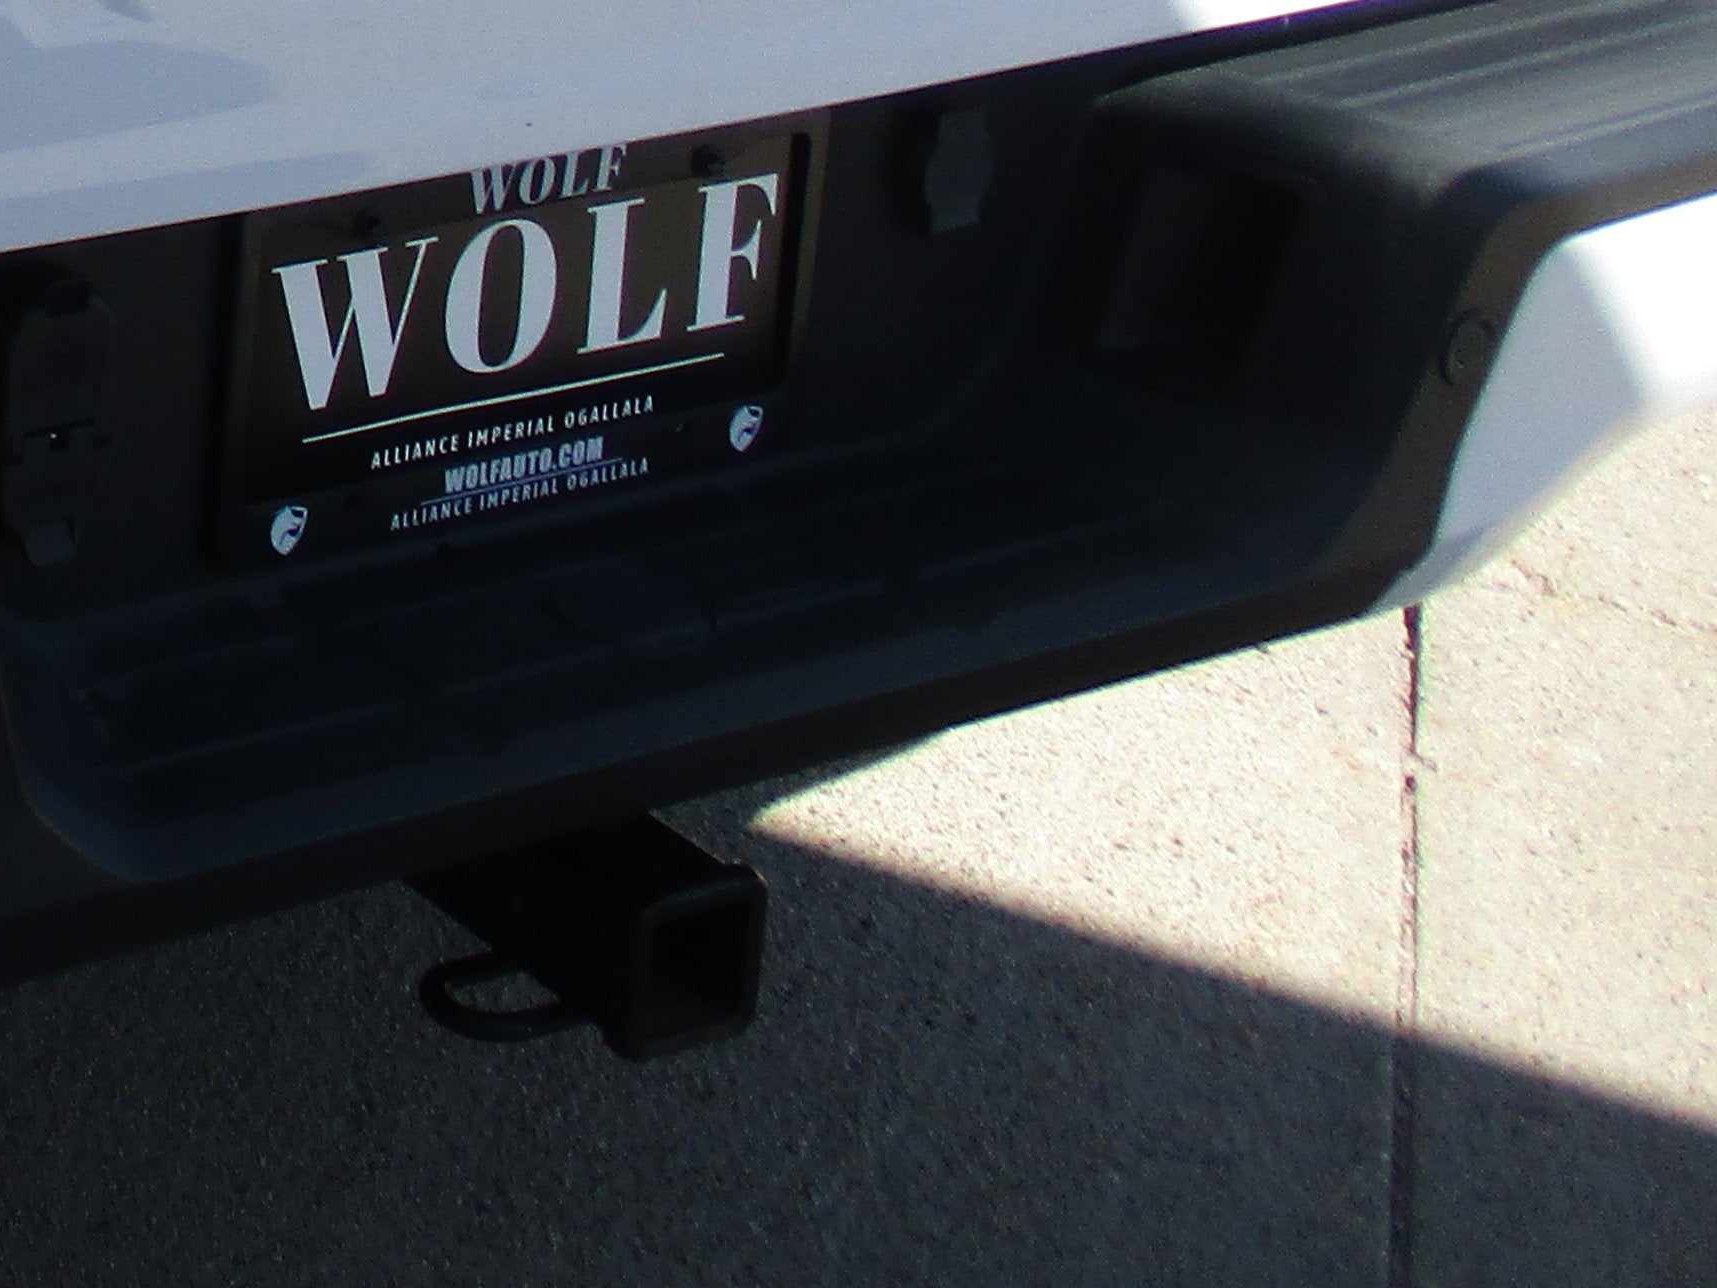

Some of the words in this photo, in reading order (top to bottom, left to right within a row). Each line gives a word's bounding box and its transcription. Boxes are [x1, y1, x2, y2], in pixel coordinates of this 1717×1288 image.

[470, 144, 627, 215] WOLF
[272, 172, 780, 412] WOLF
[370, 433, 460, 470] ALLIANCE
[467, 414, 555, 449] IMPERIAL
[564, 394, 654, 429] OGALLALA
[444, 436, 605, 494] WOLFAUTO.COM
[390, 497, 473, 531] ALLIANCE
[479, 478, 559, 511] IMPERIAL
[567, 457, 649, 491] OGALLALA
